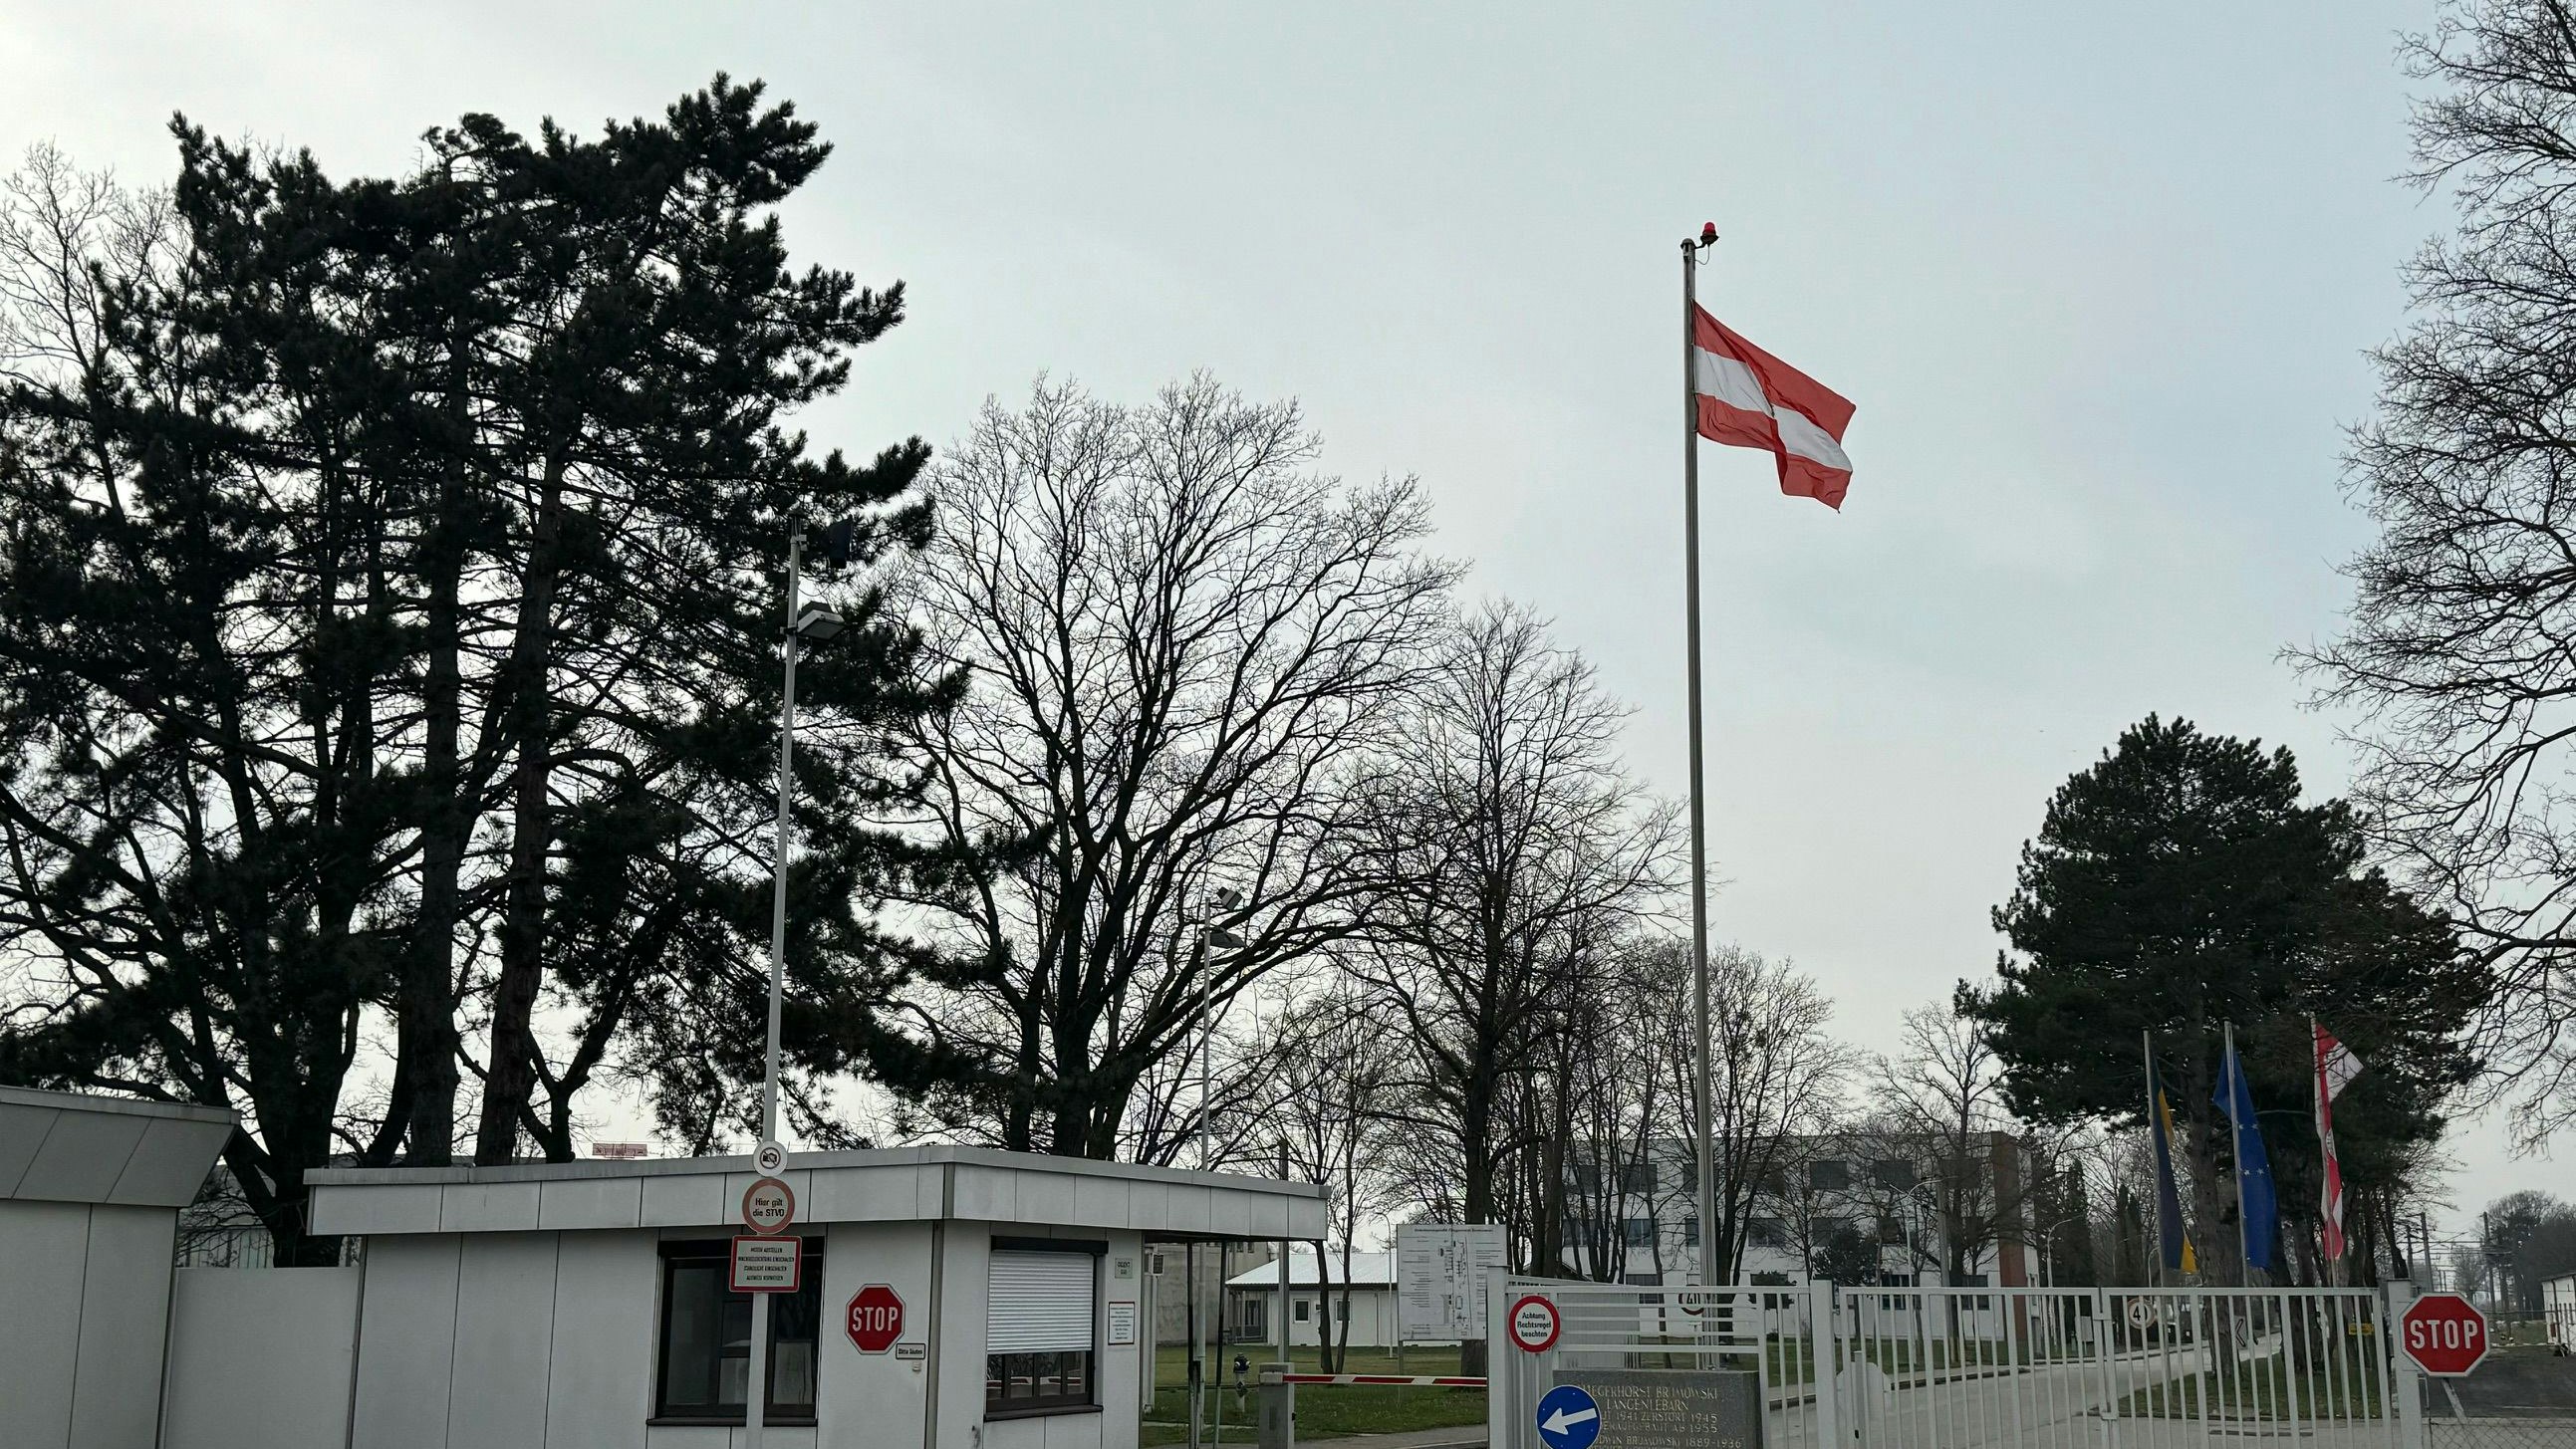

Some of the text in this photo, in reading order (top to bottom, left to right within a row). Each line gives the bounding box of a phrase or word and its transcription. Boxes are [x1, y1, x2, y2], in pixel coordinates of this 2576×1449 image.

[755, 1197, 783, 1208] Hier gilt
[752, 1208, 764, 1217] die
[852, 1307, 899, 1331] STOP
[1521, 1312, 1546, 1321] Achtung
[2410, 1320, 2478, 1349] STOP
[1606, 1398, 1689, 1411] LANGENLEBARN
[1691, 1412, 1718, 1423] 1945
[1690, 1423, 1718, 1433] 1955
